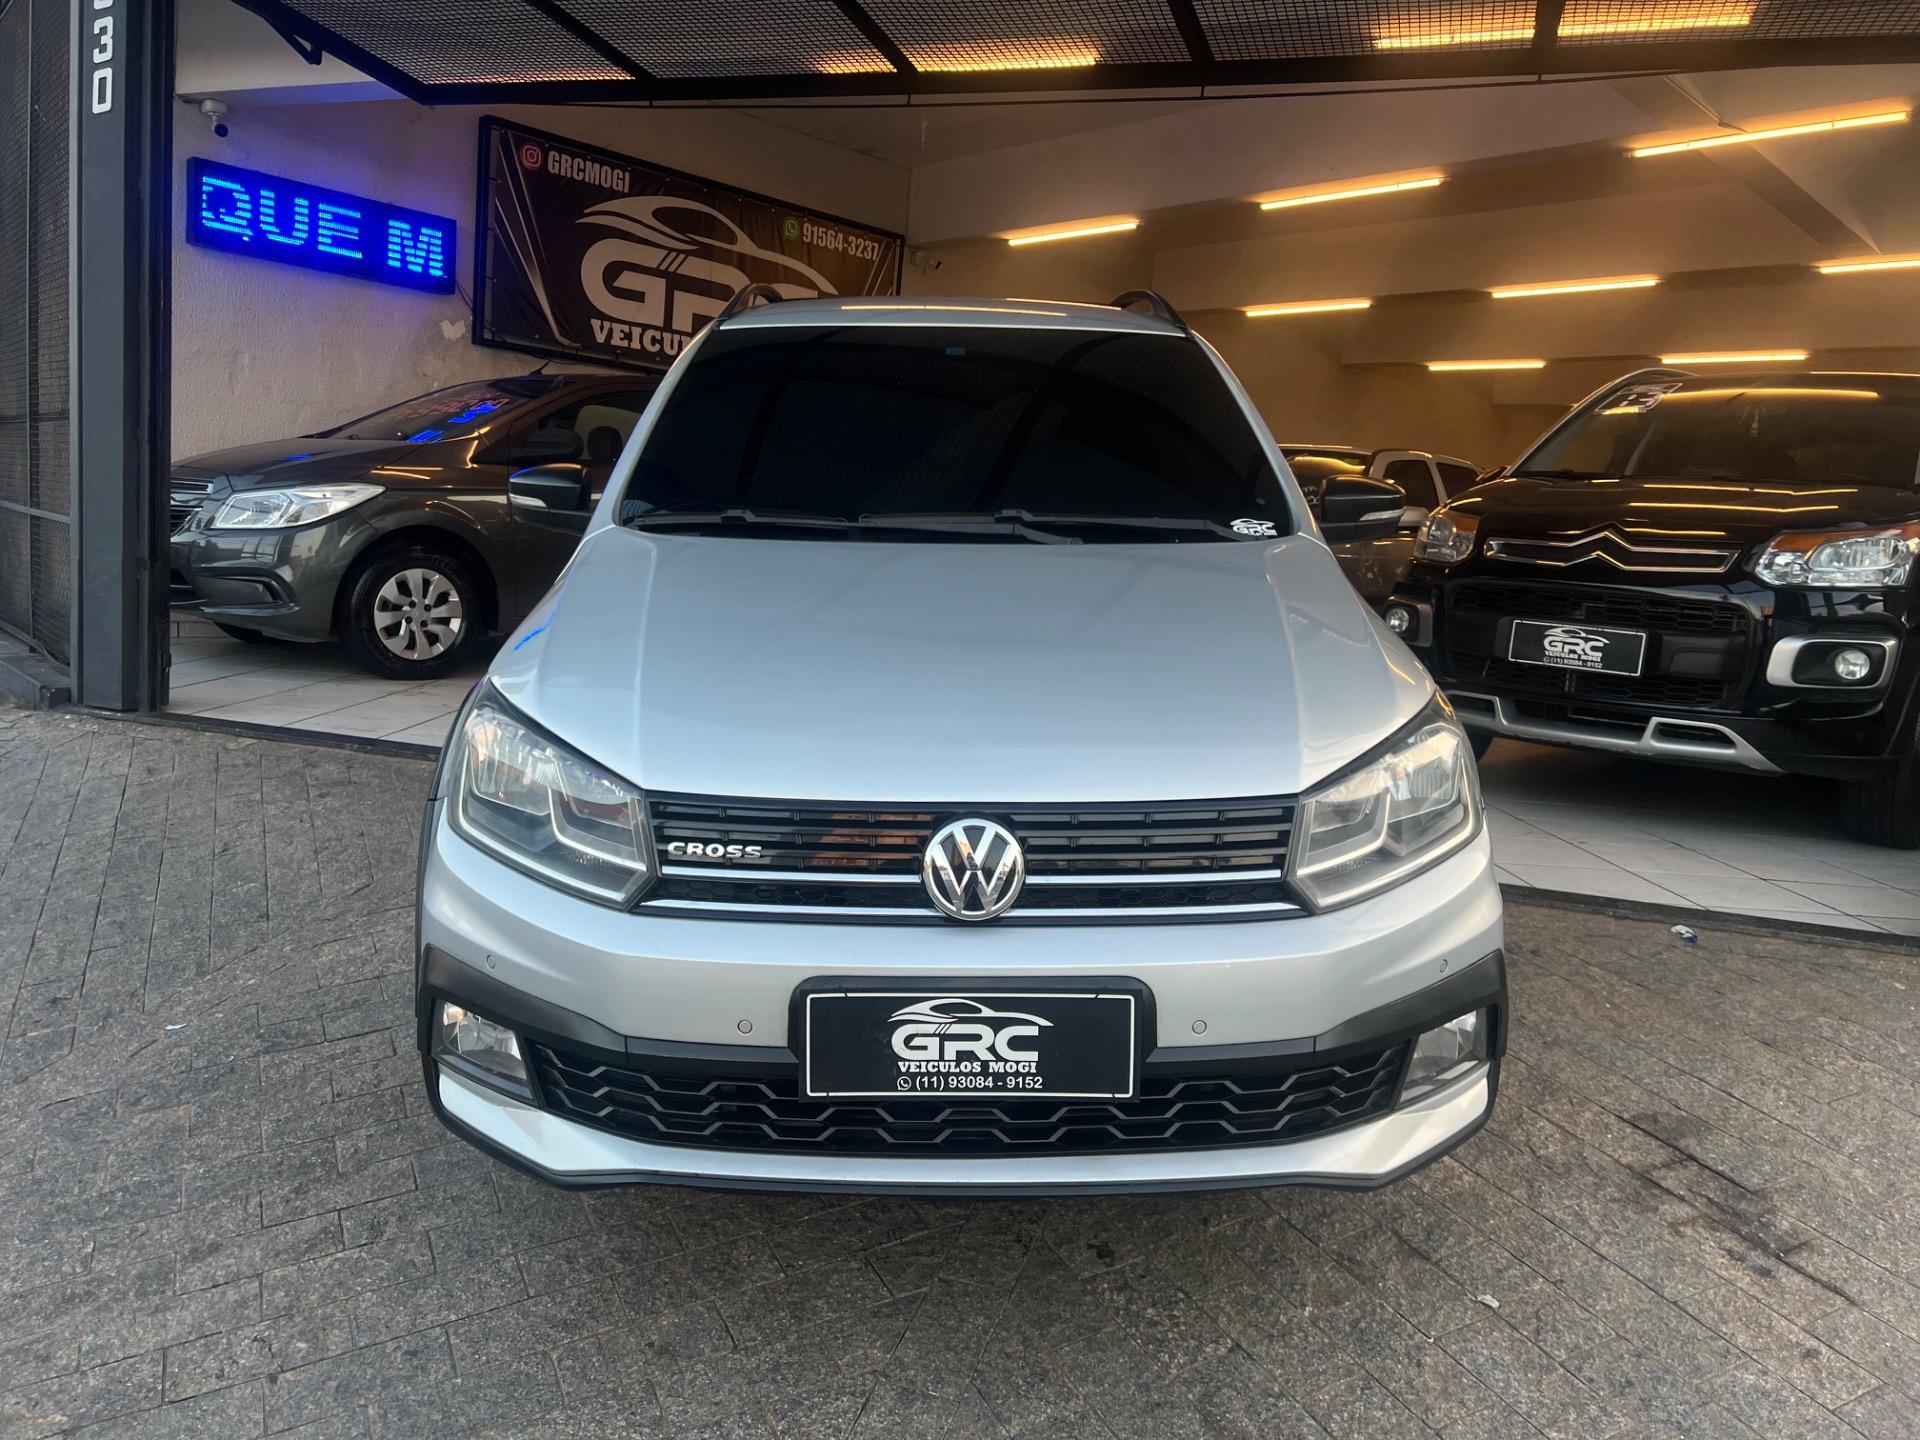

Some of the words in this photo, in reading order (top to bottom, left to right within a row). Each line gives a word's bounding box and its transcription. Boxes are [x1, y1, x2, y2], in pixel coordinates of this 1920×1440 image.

[92, 0, 113, 114] 30
[547, 150, 631, 193] GRCMOGI
[202, 176, 362, 259] QUE
[388, 219, 444, 277] M
[802, 222, 879, 261] 91564-3237
[581, 238, 818, 333] GR
[590, 318, 693, 356] VEICU
[1232, 524, 1277, 535] GRC
[1543, 636, 1604, 657] GRC
[667, 841, 762, 859] CROSS
[891, 1023, 1039, 1062] GRC
[897, 1061, 982, 1073] VEICULOS
[988, 1061, 1037, 1073] MOGI
[915, 1076, 945, 1091] (11)
[948, 1076, 994, 1089] 93084
[1006, 1076, 1043, 1089] 9152
